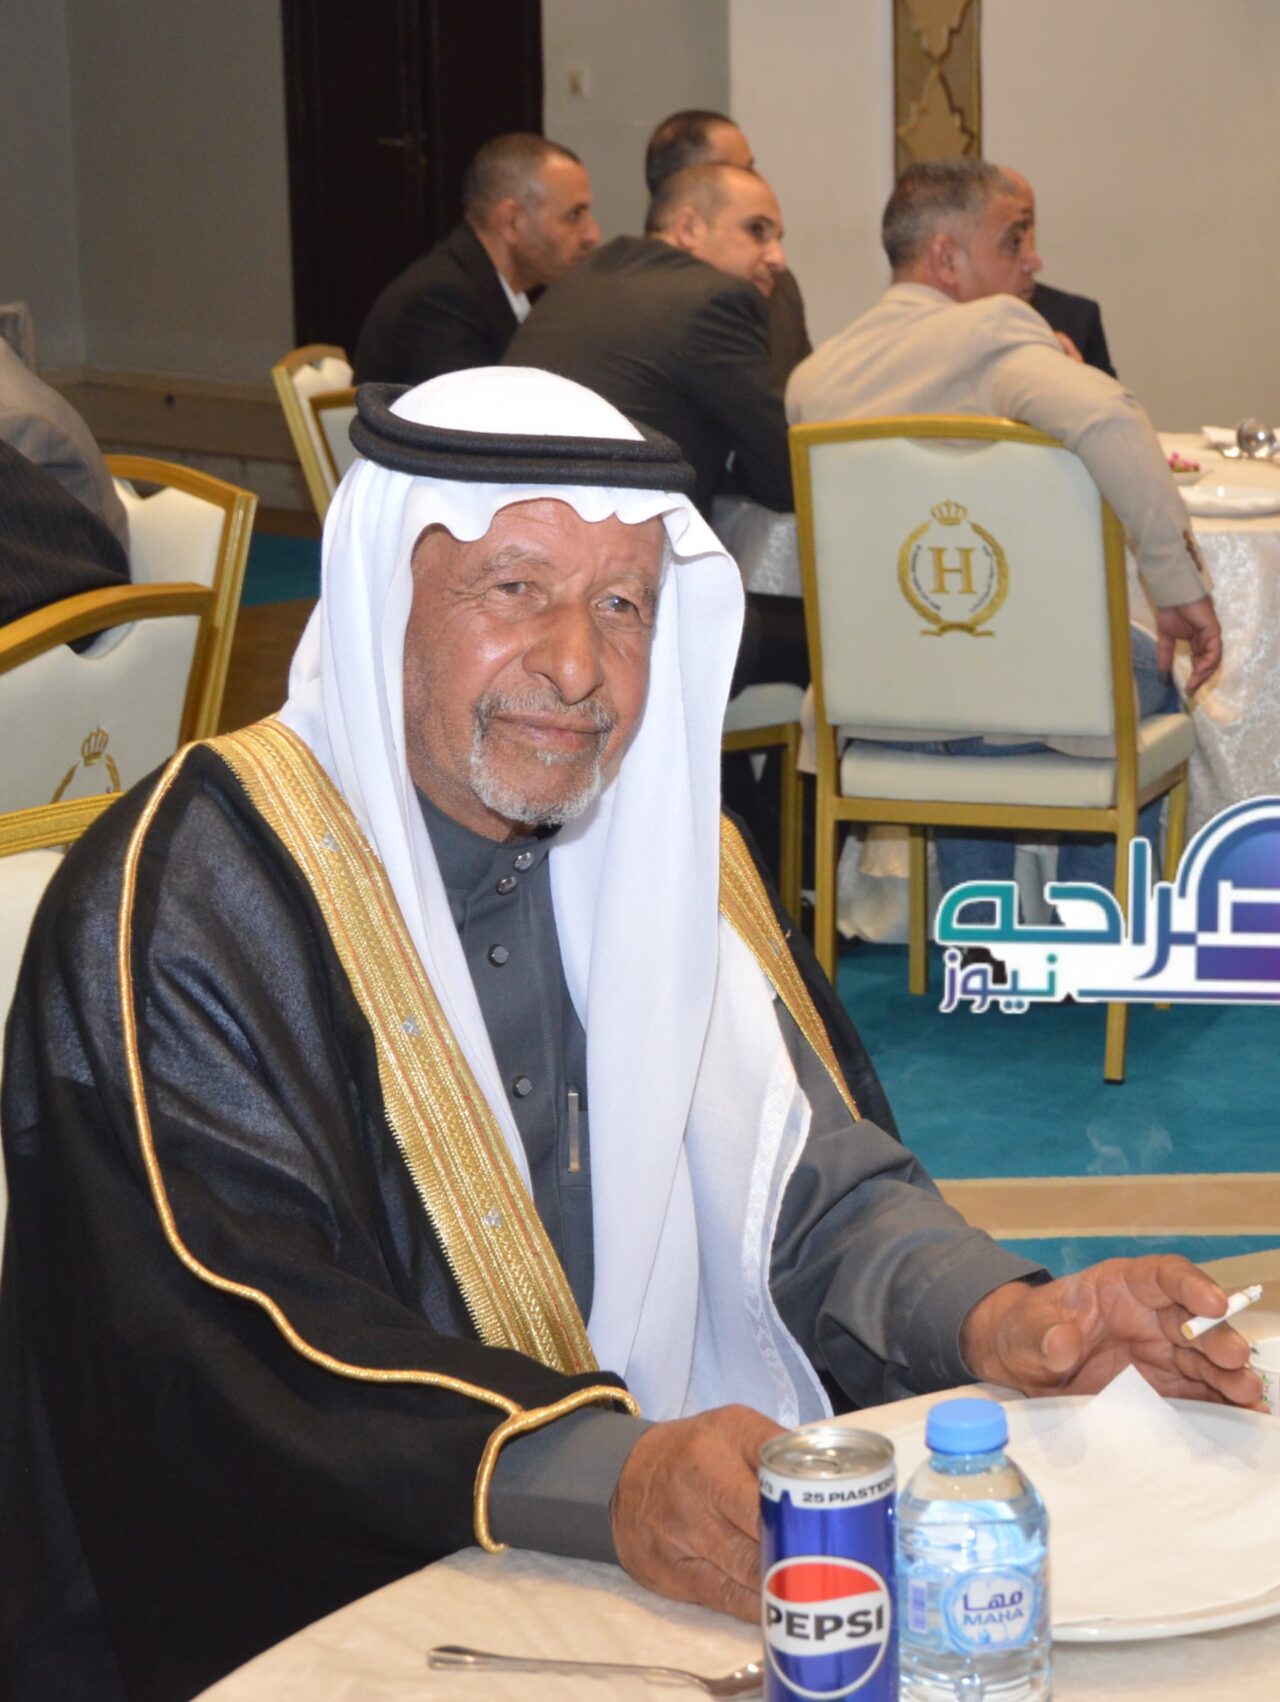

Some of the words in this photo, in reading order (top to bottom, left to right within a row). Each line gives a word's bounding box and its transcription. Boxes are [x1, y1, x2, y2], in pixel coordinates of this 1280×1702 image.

[928, 546, 977, 594] H
[803, 1491, 824, 1504] 25
[962, 1589, 1024, 1612] مها
[766, 1601, 884, 1641] PEPSI
[963, 1607, 1024, 1626] MAHA
